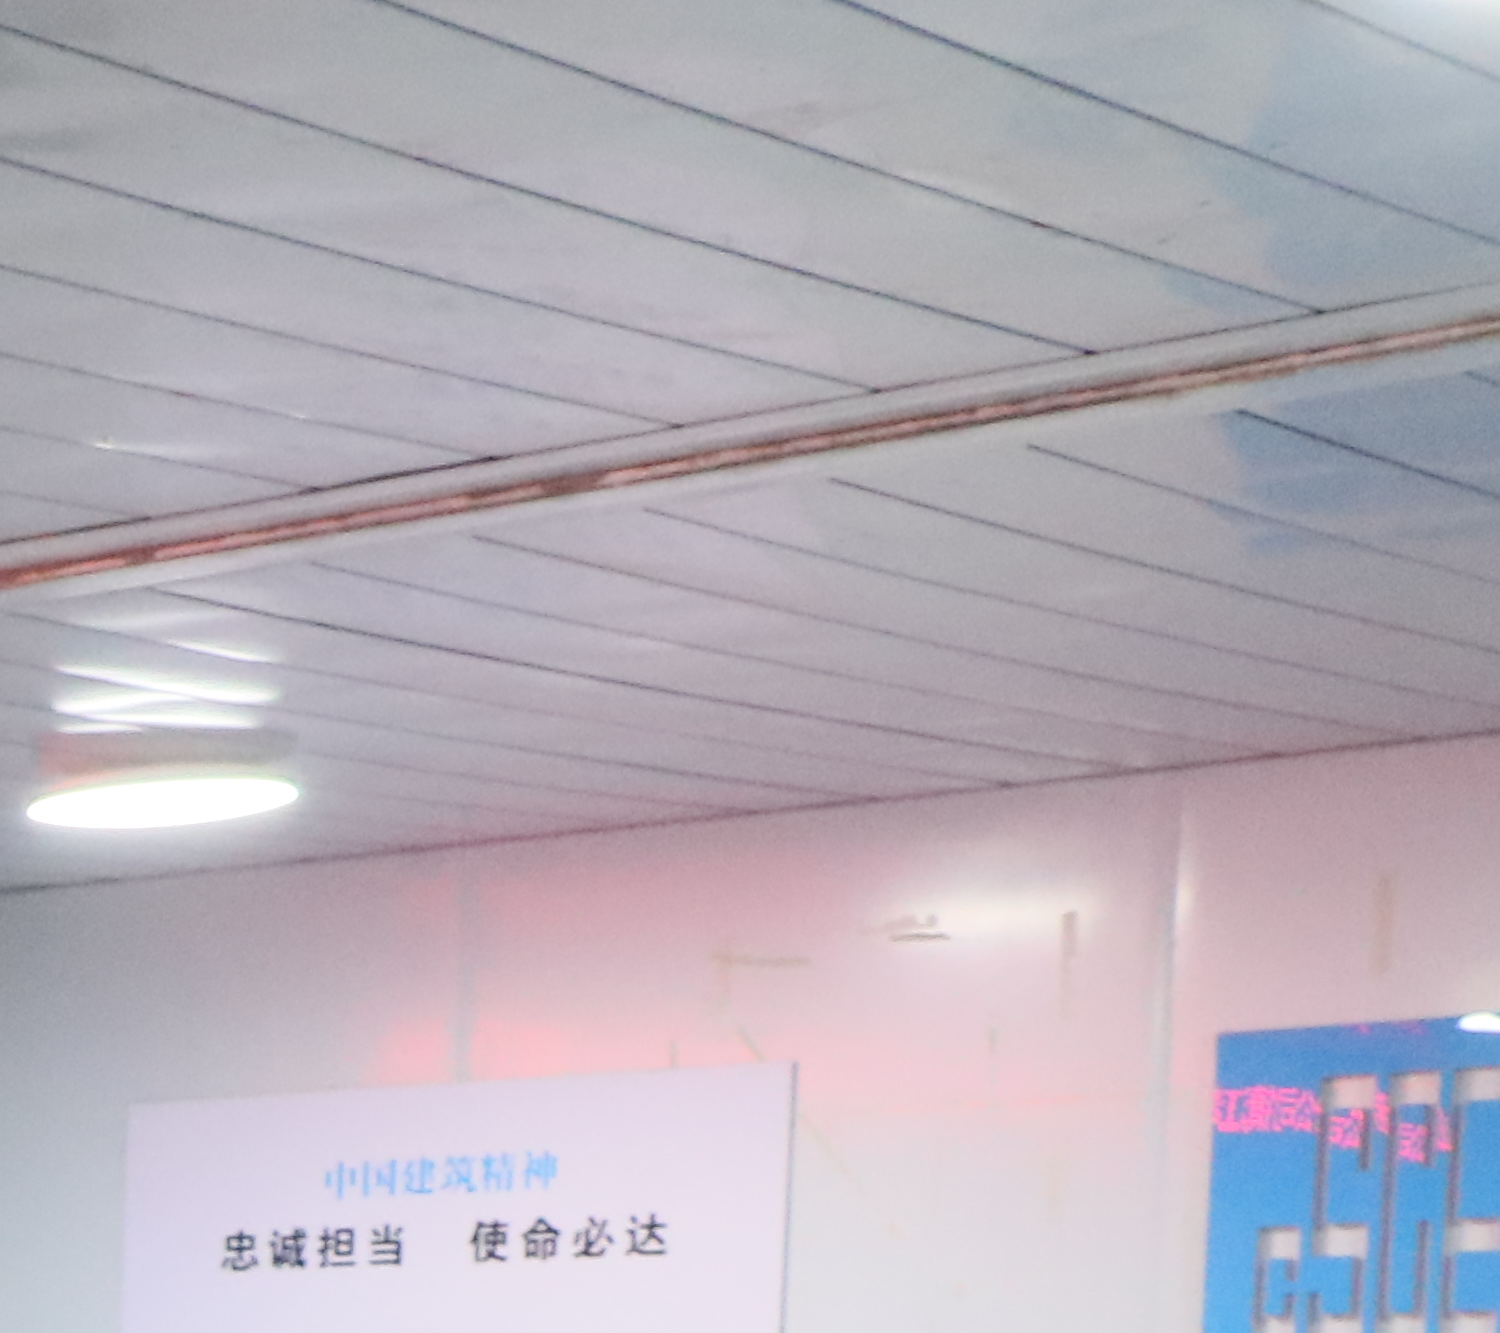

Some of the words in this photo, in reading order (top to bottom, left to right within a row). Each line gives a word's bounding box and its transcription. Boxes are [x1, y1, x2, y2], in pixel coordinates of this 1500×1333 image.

[324, 1150, 559, 1200] 中国建筑精神
[220, 1224, 405, 1272] 忠诚担当
[470, 1213, 668, 1264] 使命必达
